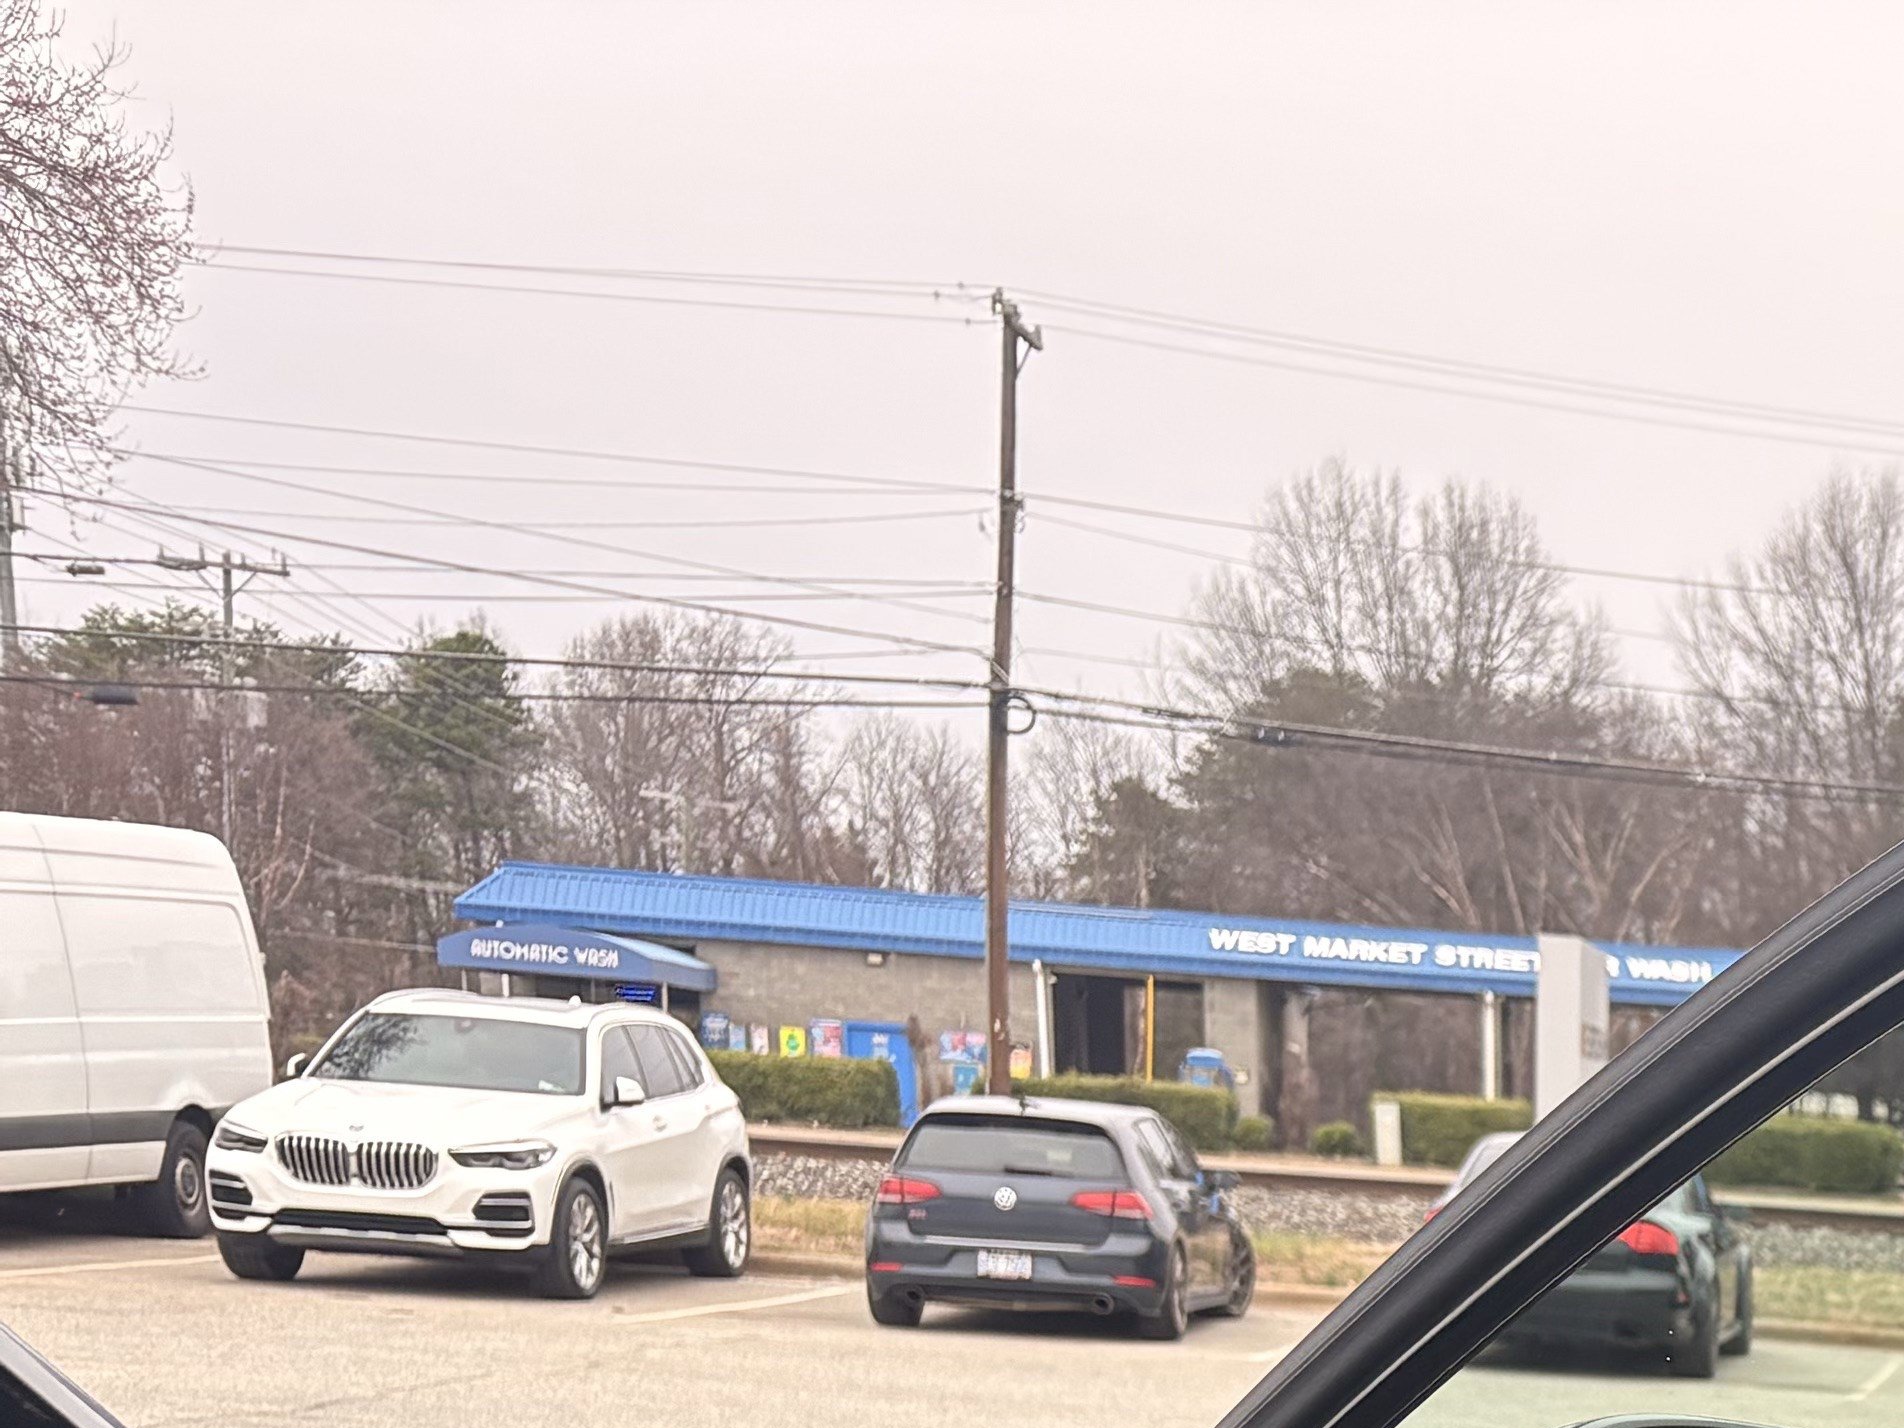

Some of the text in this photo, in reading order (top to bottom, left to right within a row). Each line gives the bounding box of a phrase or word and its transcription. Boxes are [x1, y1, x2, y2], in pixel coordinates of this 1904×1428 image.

[470, 938, 620, 969] AUTOMATIC WASH
[1208, 927, 1297, 956] WEST
[1302, 934, 1429, 966] MARKET
[1625, 955, 1713, 983] WASH
